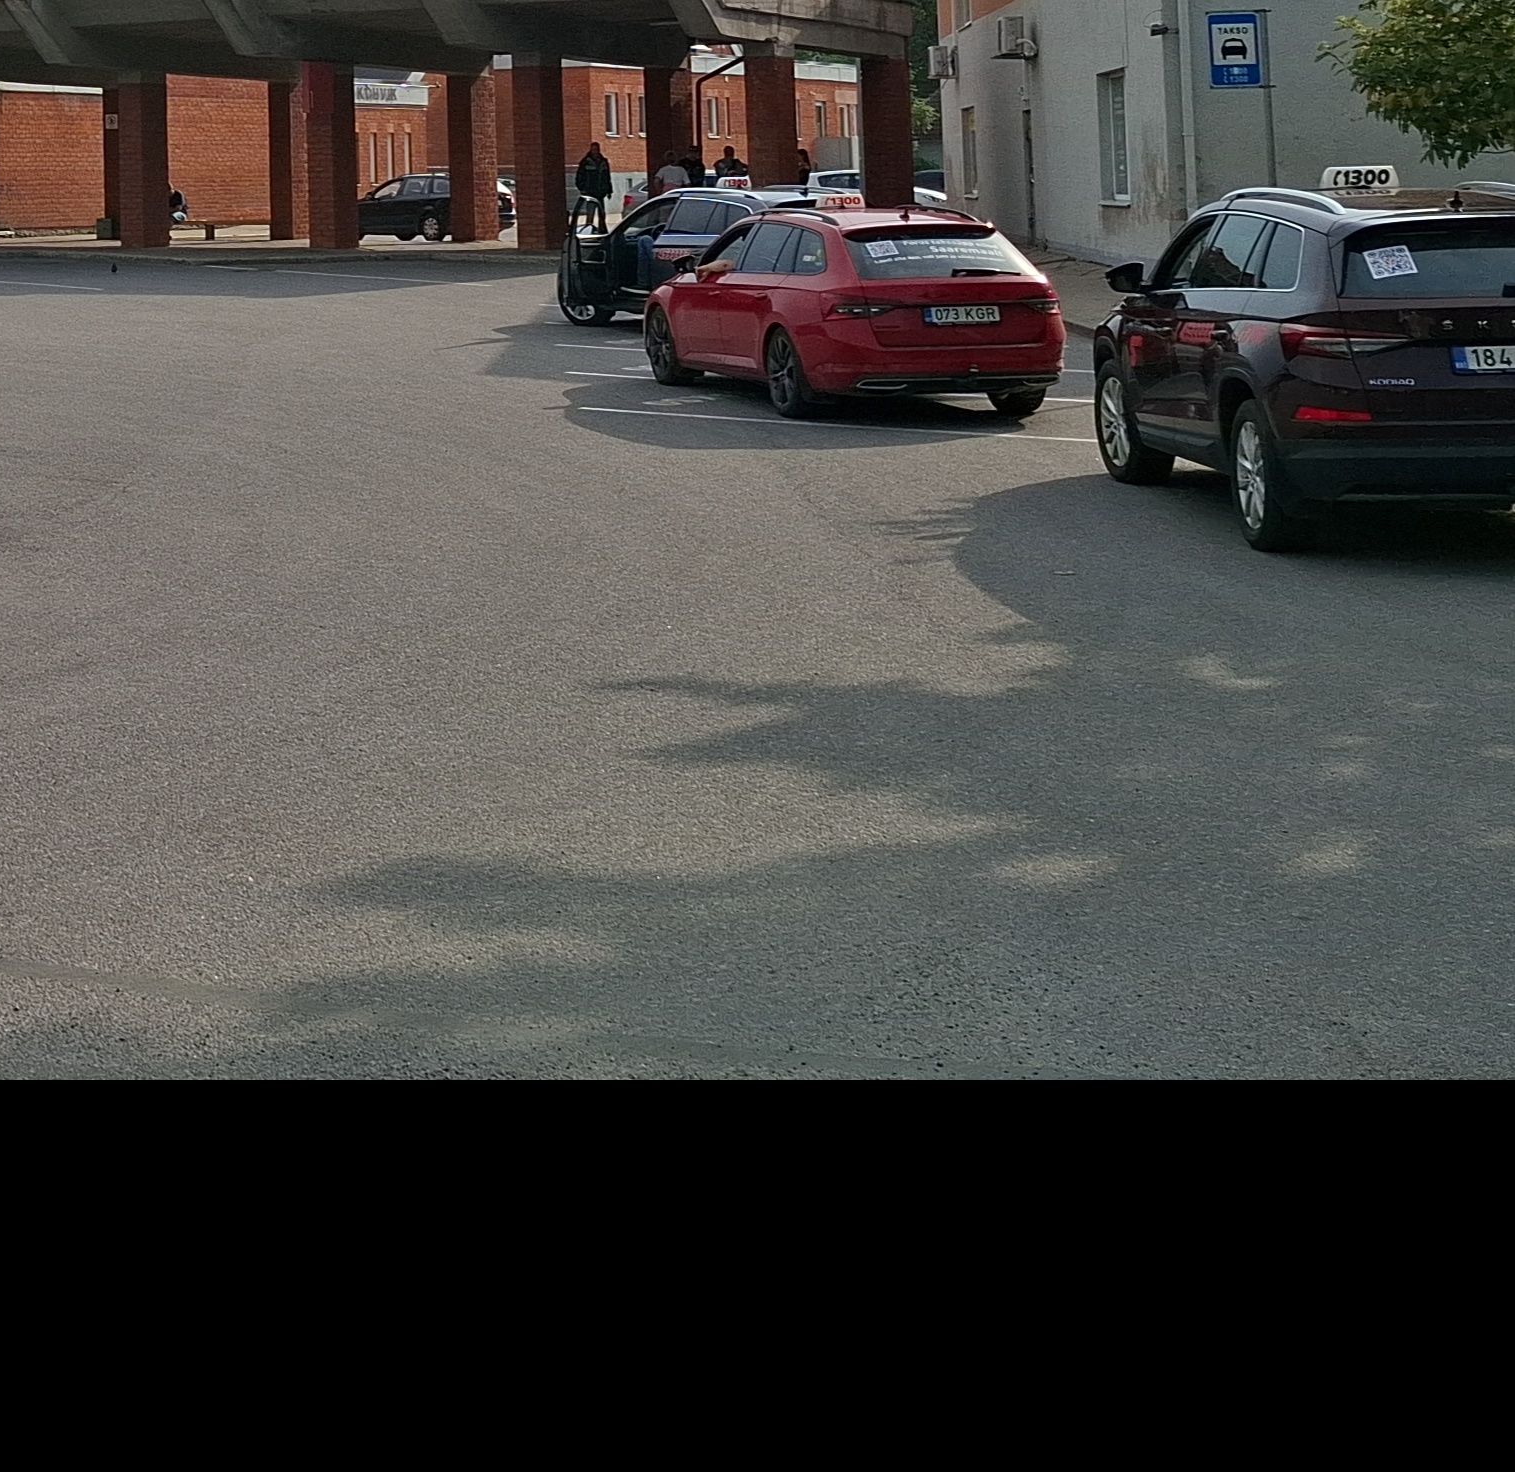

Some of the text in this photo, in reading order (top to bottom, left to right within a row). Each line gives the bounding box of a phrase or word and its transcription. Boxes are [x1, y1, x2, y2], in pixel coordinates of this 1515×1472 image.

[1217, 27, 1248, 35] TAKSO
[1343, 169, 1390, 186] 1300
[829, 197, 861, 206] 1300
[935, 307, 996, 321] 073 KGR
[1471, 348, 1513, 367] 184
[1369, 378, 1415, 386] KODIAQ
